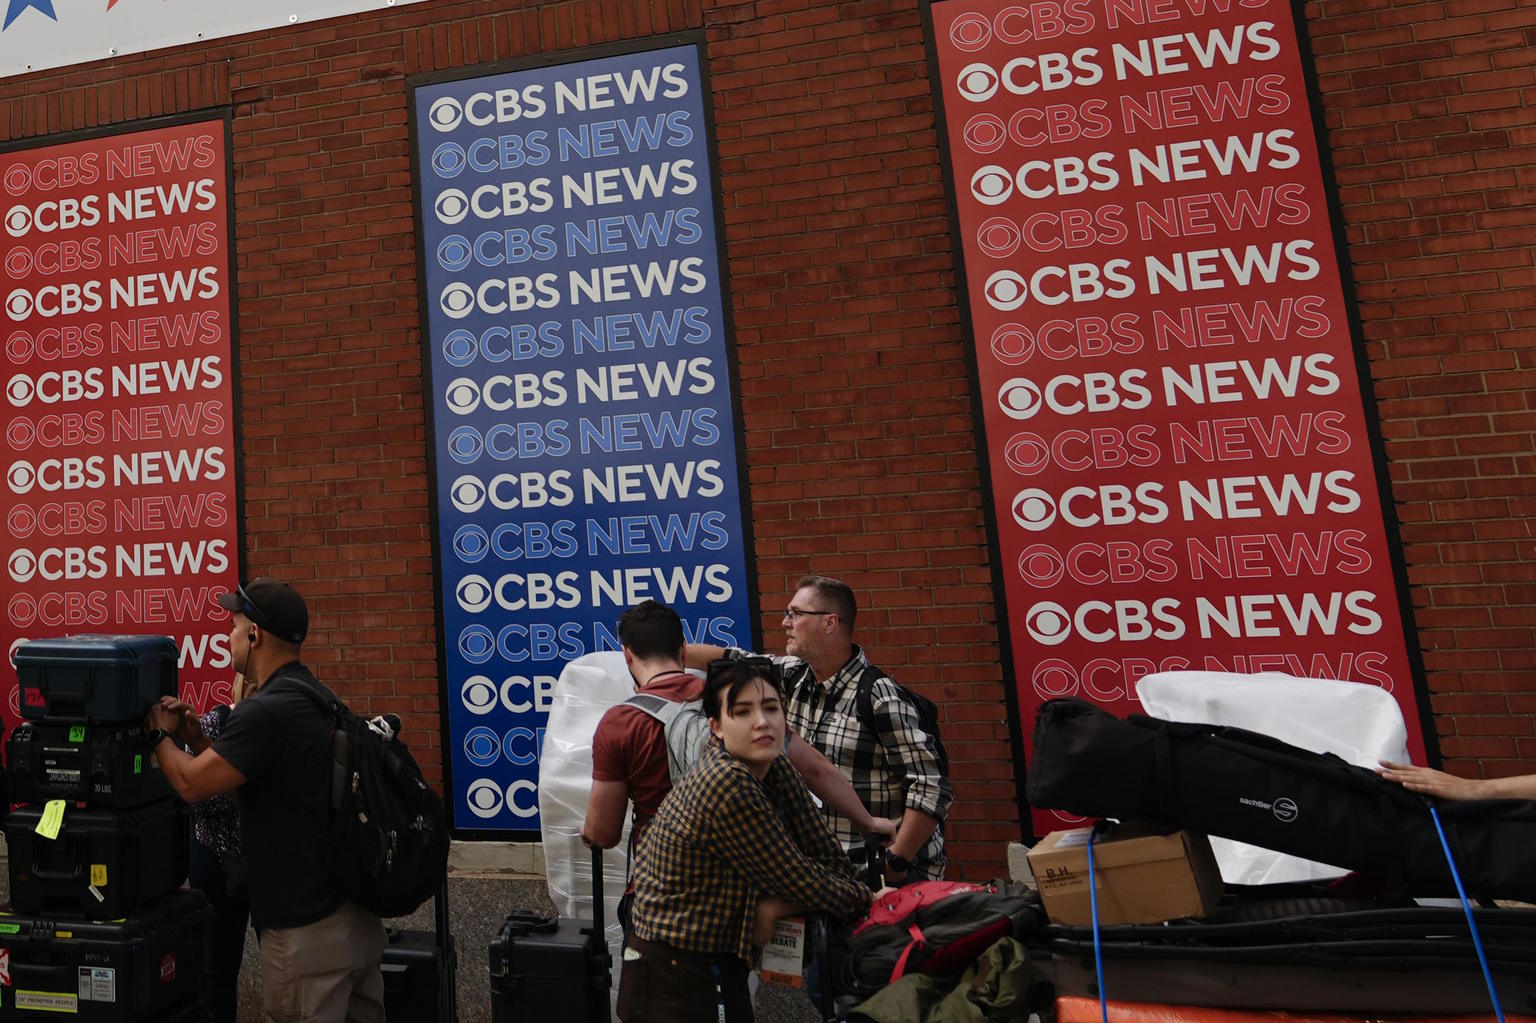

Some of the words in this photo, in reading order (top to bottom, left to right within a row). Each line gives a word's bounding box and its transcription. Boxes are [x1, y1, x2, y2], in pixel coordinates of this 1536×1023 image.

[1001, 48, 1103, 95] CBS
[1112, 21, 1280, 80] NEWS
[465, 85, 546, 126] CBS
[555, 63, 688, 115] NEWS
[1008, 99, 1111, 147] CBS
[1120, 74, 1291, 134] NEWS
[33, 153, 99, 191] CBS
[106, 135, 215, 180] NEWS
[468, 130, 550, 173] CBS
[558, 111, 693, 161] NEWS
[1016, 152, 1119, 198] CBS
[1129, 129, 1300, 186] NEWS
[34, 195, 101, 232] CBS
[108, 179, 217, 223] NEWS
[471, 178, 554, 219] CBS
[562, 159, 697, 209] NEWS
[474, 225, 557, 266] CBS
[565, 208, 702, 257] NEWS
[1022, 204, 1128, 253] CBS
[1136, 183, 1311, 241] NEWS
[34, 237, 102, 275] CBS
[109, 222, 218, 266] NEWS
[1030, 259, 1135, 305] CBS
[1145, 239, 1320, 295] NEWS
[35, 281, 103, 317] CBS
[110, 266, 220, 309] NEWS
[477, 273, 560, 314] CBS
[569, 257, 706, 305] NEWS
[35, 323, 104, 361] CBS
[111, 310, 222, 353] NEWS
[479, 321, 564, 362] CBS
[572, 306, 711, 354] NEWS
[1037, 312, 1144, 360] CBS
[1153, 295, 1330, 350] NEWS
[36, 367, 104, 403] CBS
[112, 356, 223, 397] NEWS
[482, 371, 567, 411] CBS
[576, 357, 715, 404] NEWS
[1045, 369, 1152, 415] CBS
[1162, 353, 1340, 406] NEWS
[37, 411, 105, 447] CBS
[112, 400, 225, 441] NEWS
[485, 419, 571, 461] CBS
[579, 407, 720, 454] NEWS
[1052, 424, 1160, 472] CBS
[1169, 411, 1351, 464] NEWS
[37, 456, 106, 491] CBS
[114, 447, 226, 486] NEWS
[488, 469, 574, 510] CBS
[582, 459, 724, 505] NEWS
[38, 500, 107, 536] CBS
[115, 492, 228, 532] NEWS
[1059, 482, 1169, 528] CBS
[1179, 470, 1361, 521] NEWS
[38, 546, 108, 581] CBS
[116, 539, 229, 577] NEWS
[490, 519, 578, 560] CBS
[587, 511, 729, 556] NEWS
[1066, 538, 1178, 585] CBS
[1188, 529, 1372, 580] NEWS
[38, 591, 109, 626] CBS
[116, 585, 231, 624] NEWS
[494, 569, 581, 611] CBS
[591, 564, 733, 607] NEWS
[497, 621, 585, 662] CBS
[1074, 597, 1186, 643] CBS
[1196, 590, 1383, 639] NEWS
[178, 634, 231, 669] WS
[500, 675, 557, 714] CB
[770, 936, 797, 949] DEBATE
